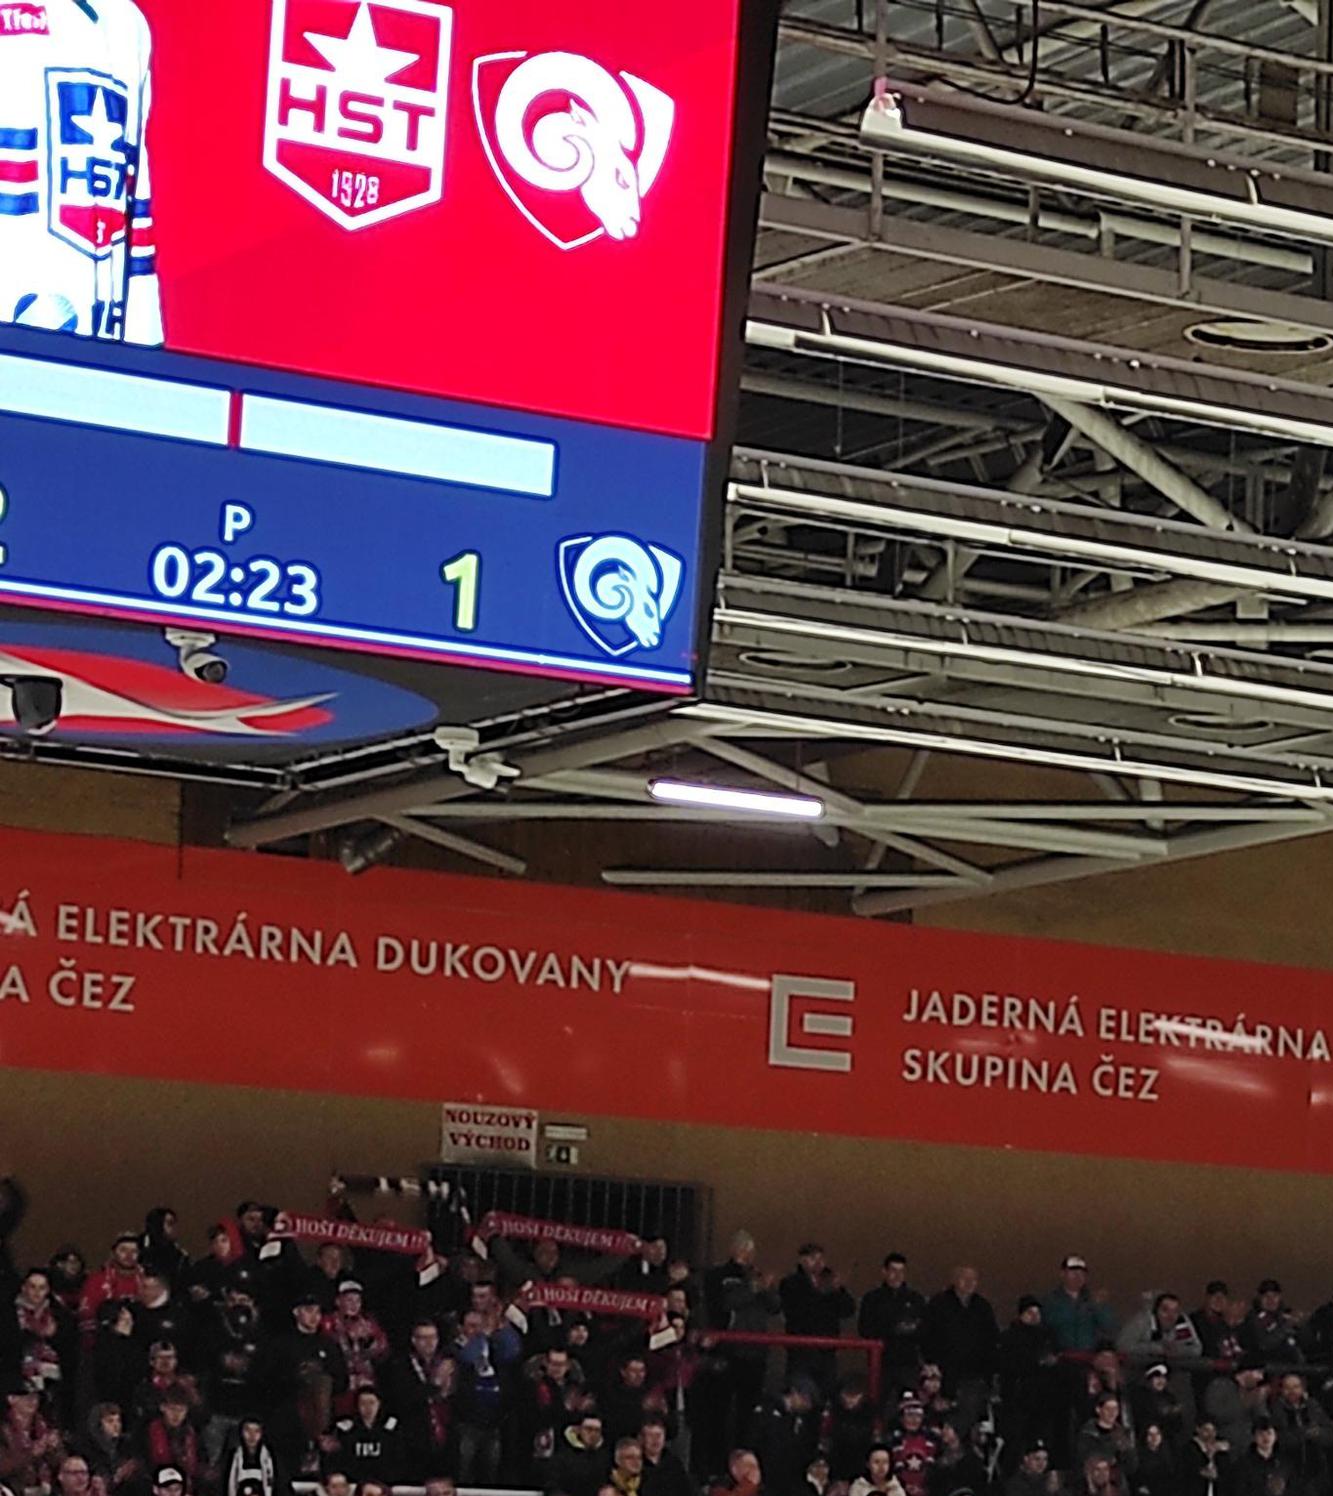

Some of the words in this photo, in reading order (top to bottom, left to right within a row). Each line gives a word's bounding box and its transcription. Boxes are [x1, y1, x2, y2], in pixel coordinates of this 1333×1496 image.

[277, 76, 437, 152] HST
[331, 168, 381, 209] 1928
[222, 502, 252, 542] P
[152, 545, 320, 617] 02:23
[440, 552, 482, 631] 1
[56, 902, 360, 970] ELEKTRÁRNA
[375, 936, 631, 997] DUKOVANY
[49, 957, 137, 1014] ČEZ
[902, 988, 1084, 1040] JADERNÁ
[1098, 1006, 1332, 1064] ELEKTRÁRNA
[902, 1047, 1080, 1098] SKUPINA
[1090, 1054, 1161, 1103] ČEZ
[445, 1109, 537, 1129] NOUZOVÝ
[448, 1130, 531, 1151] VÝCHOD
